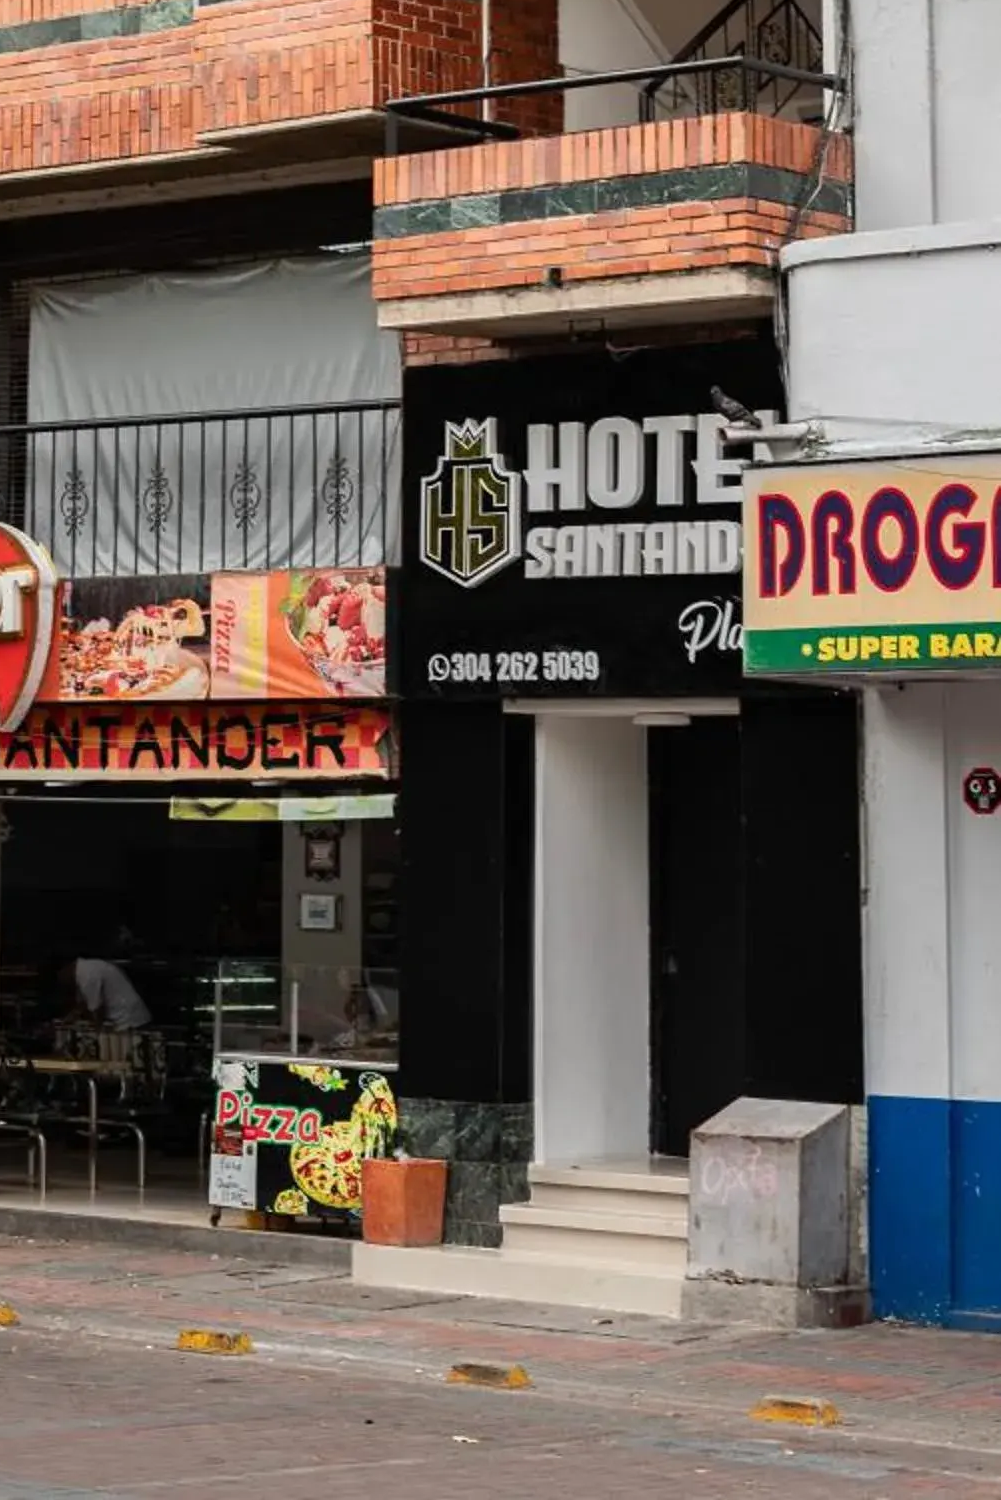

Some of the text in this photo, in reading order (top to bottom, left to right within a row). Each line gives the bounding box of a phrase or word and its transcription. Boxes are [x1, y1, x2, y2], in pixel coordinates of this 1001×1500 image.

[524, 519, 744, 579] SANTAND
[758, 483, 1001, 598] DROG
[214, 599, 236, 673] Pizza
[818, 633, 1001, 662] SUPER BAR
[450, 650, 599, 682] 304 262 5039
[216, 1088, 321, 1144] Pizza
